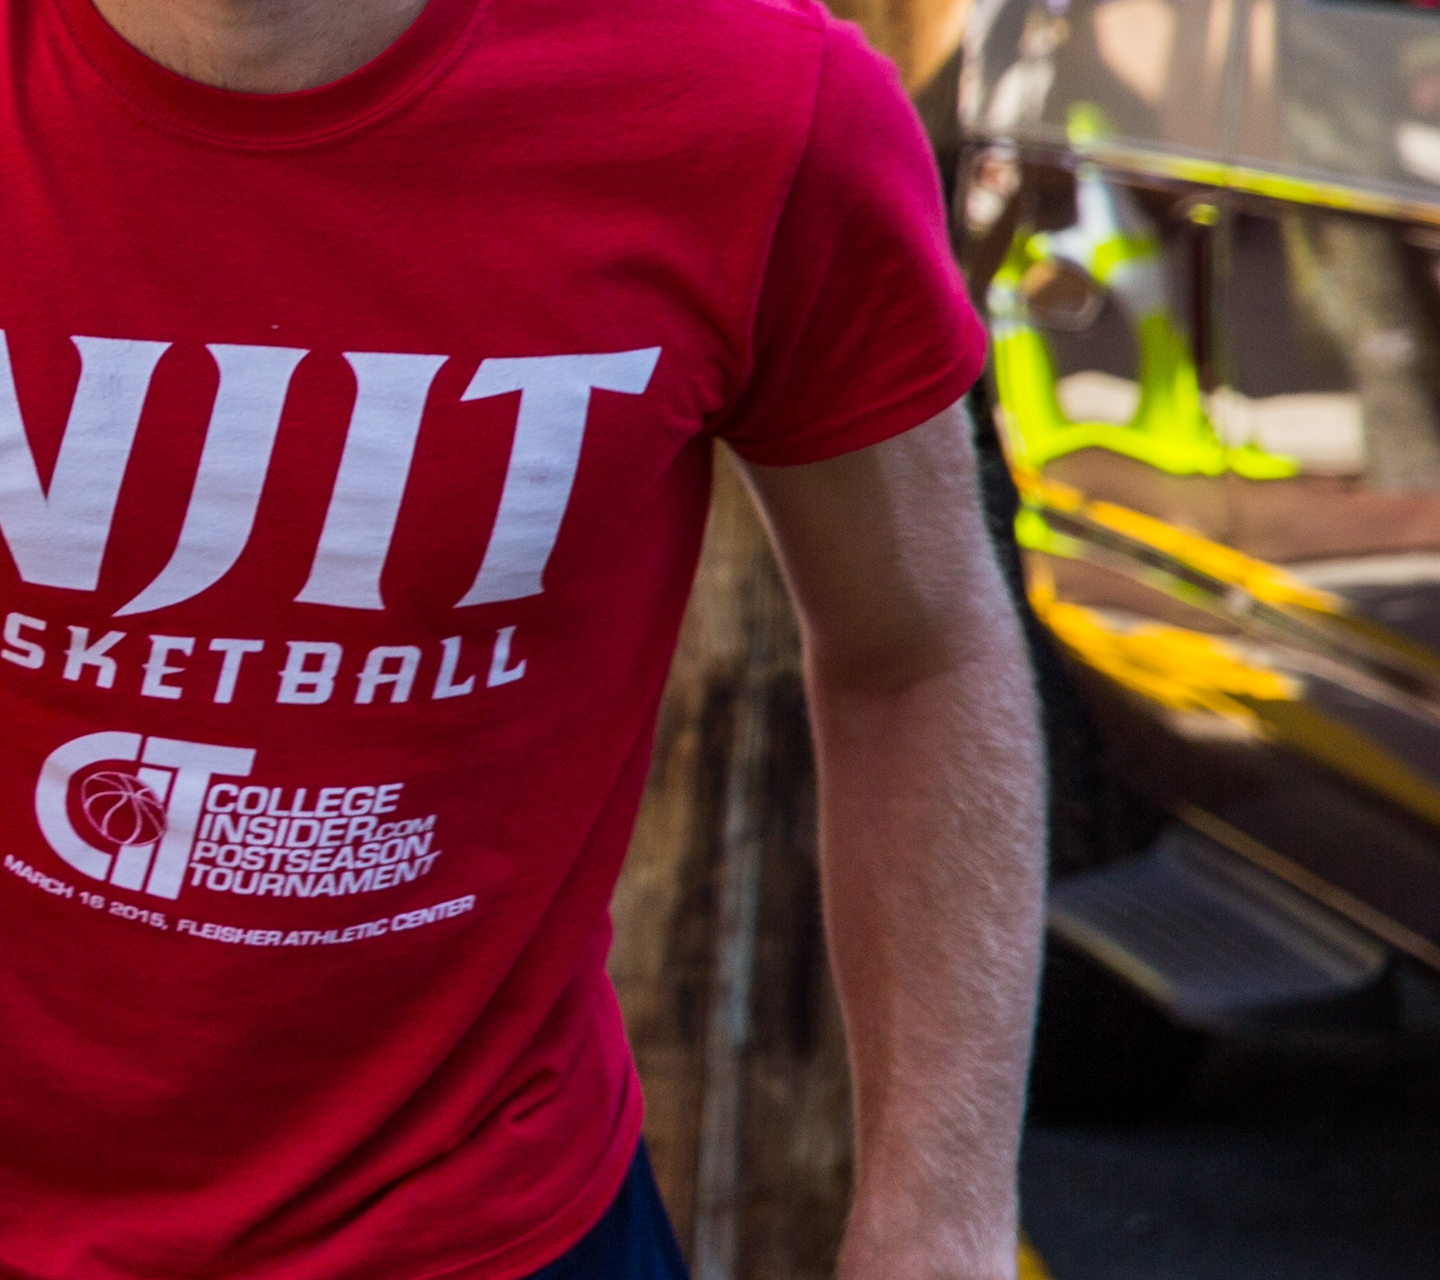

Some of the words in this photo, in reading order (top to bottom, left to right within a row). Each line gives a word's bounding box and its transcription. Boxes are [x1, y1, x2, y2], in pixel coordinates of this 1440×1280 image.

[205, 782, 404, 818] COLLEGE
[190, 850, 442, 898] TOURNAMENT
[192, 832, 434, 873] POSTSEASON
[3, 853, 74, 899] MARCH
[176, 918, 282, 947] FLEISHER
[282, 918, 389, 947] ATHLETIC
[390, 894, 477, 932] CENTER
